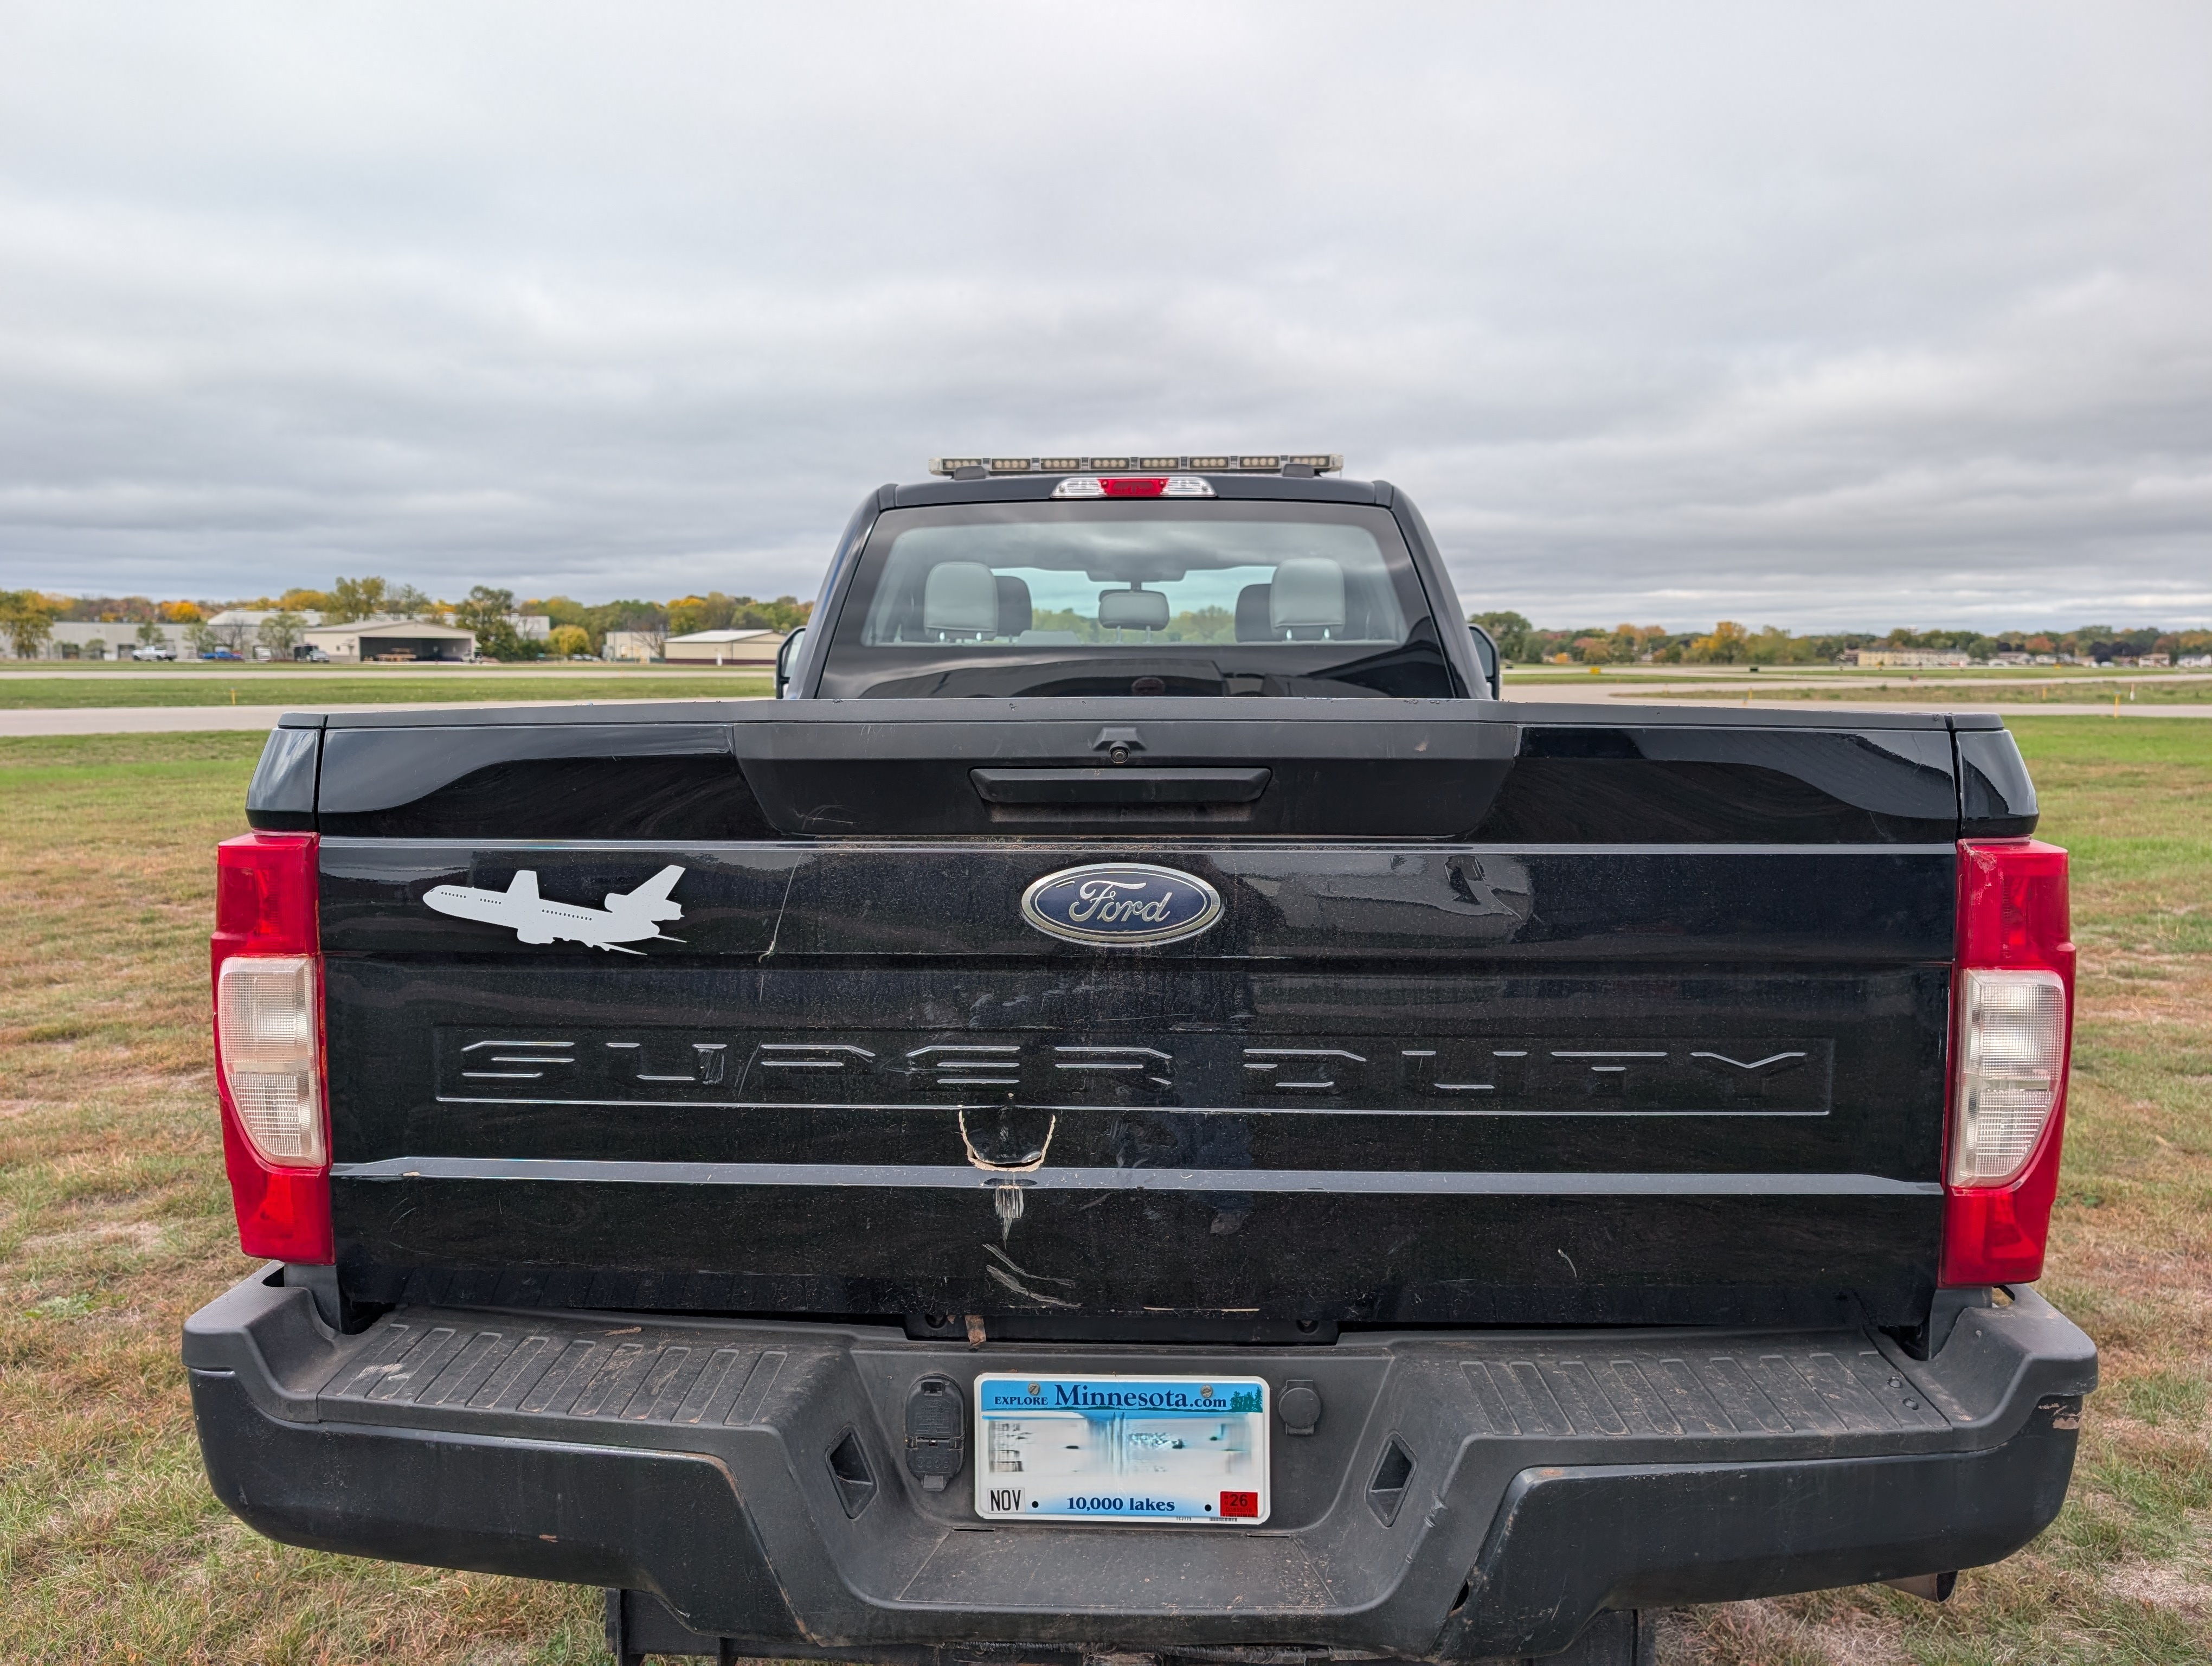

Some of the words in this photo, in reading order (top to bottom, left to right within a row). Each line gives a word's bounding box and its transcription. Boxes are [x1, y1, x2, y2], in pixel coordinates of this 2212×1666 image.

[1069, 880, 1173, 922] Ford
[460, 1040, 1174, 1095] SUPER
[1242, 1048, 1809, 1097] DUTY
[994, 1396, 1049, 1405] EXPLORE
[1054, 1384, 1227, 1408] Minnesota.com
[990, 1490, 1021, 1511] NOV
[1066, 1497, 1123, 1511] 10,000
[1129, 1498, 1175, 1511] lakes
[1230, 1494, 1248, 1507] 26
